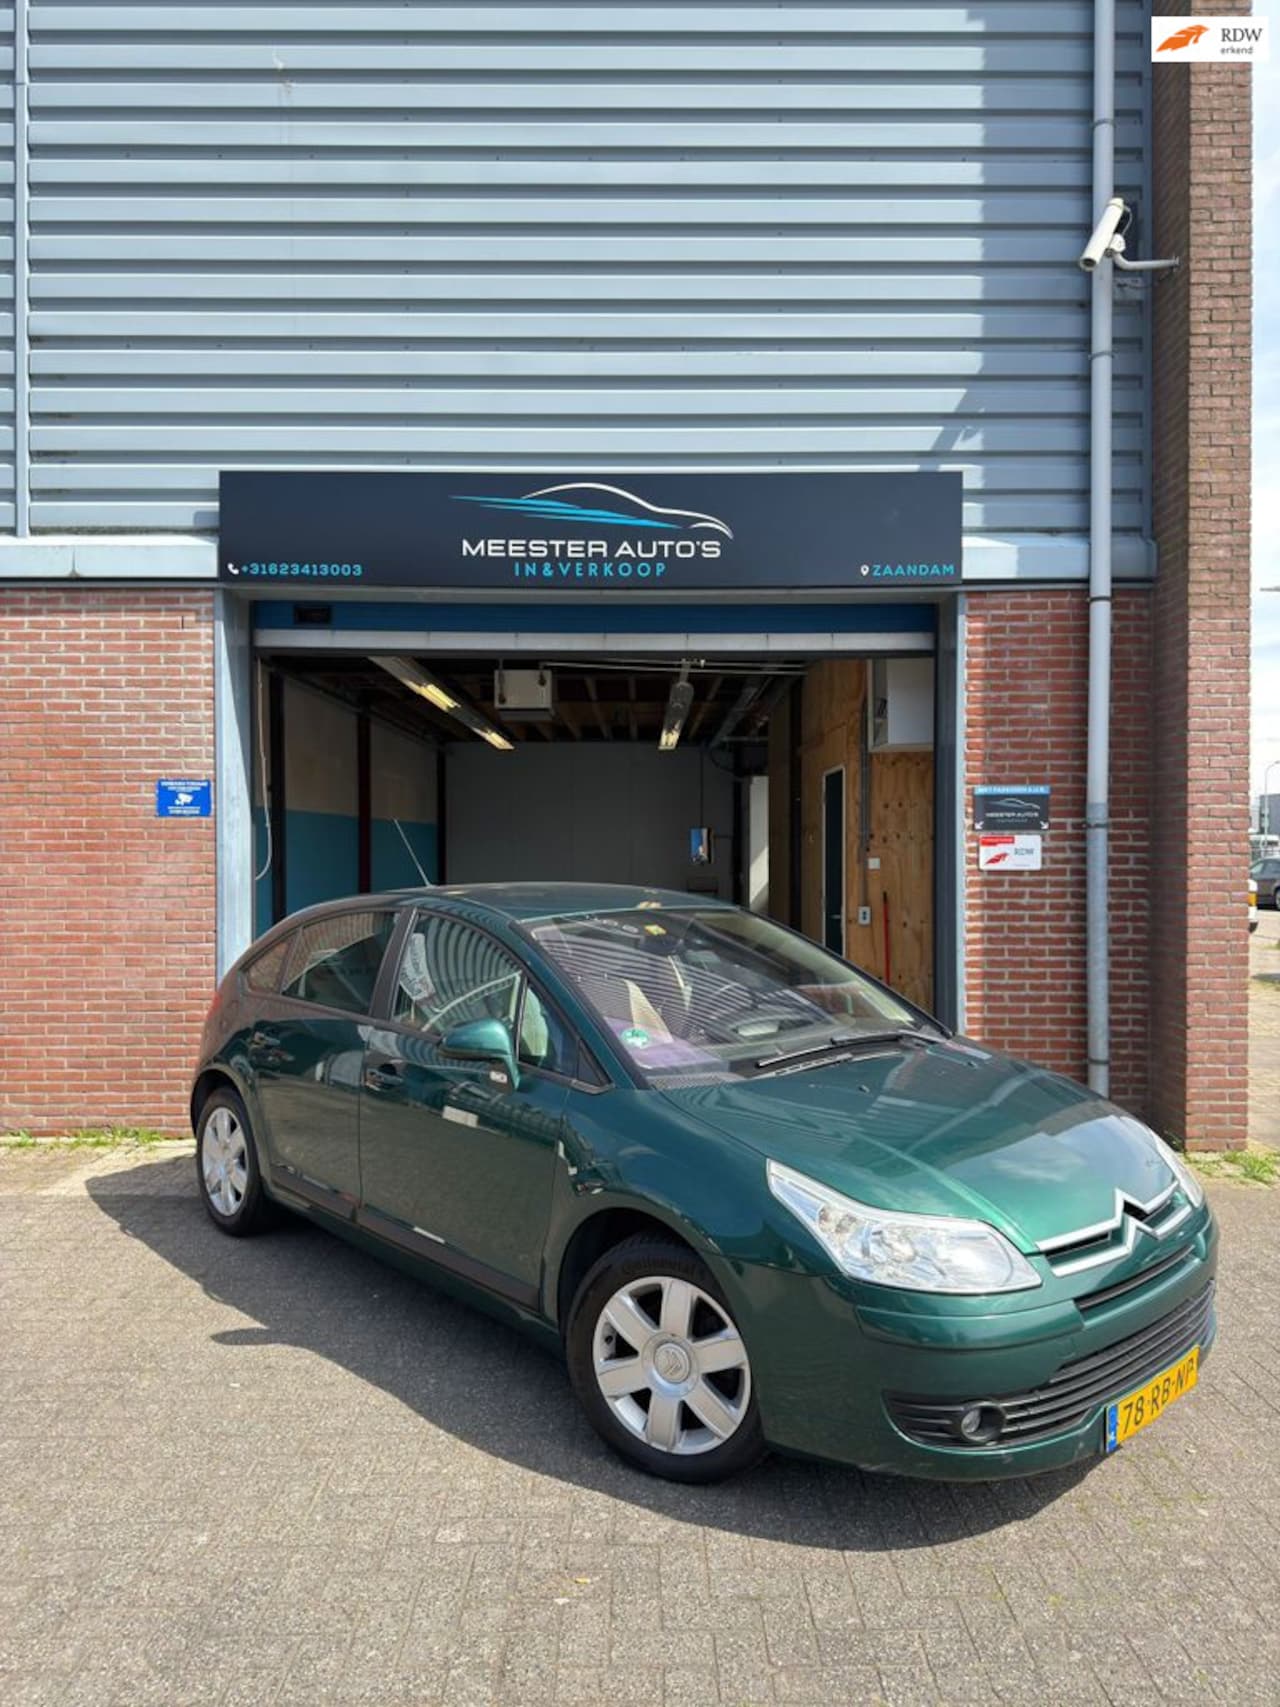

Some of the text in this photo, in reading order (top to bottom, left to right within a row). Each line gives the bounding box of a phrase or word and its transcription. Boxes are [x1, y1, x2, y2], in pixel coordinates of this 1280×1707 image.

[462, 539, 721, 560] MEESTER AUTO'S
[241, 563, 363, 577] +31623413003
[872, 564, 955, 577] ZAANDAM
[1123, 1357, 1195, 1434] 78-RB-NP
